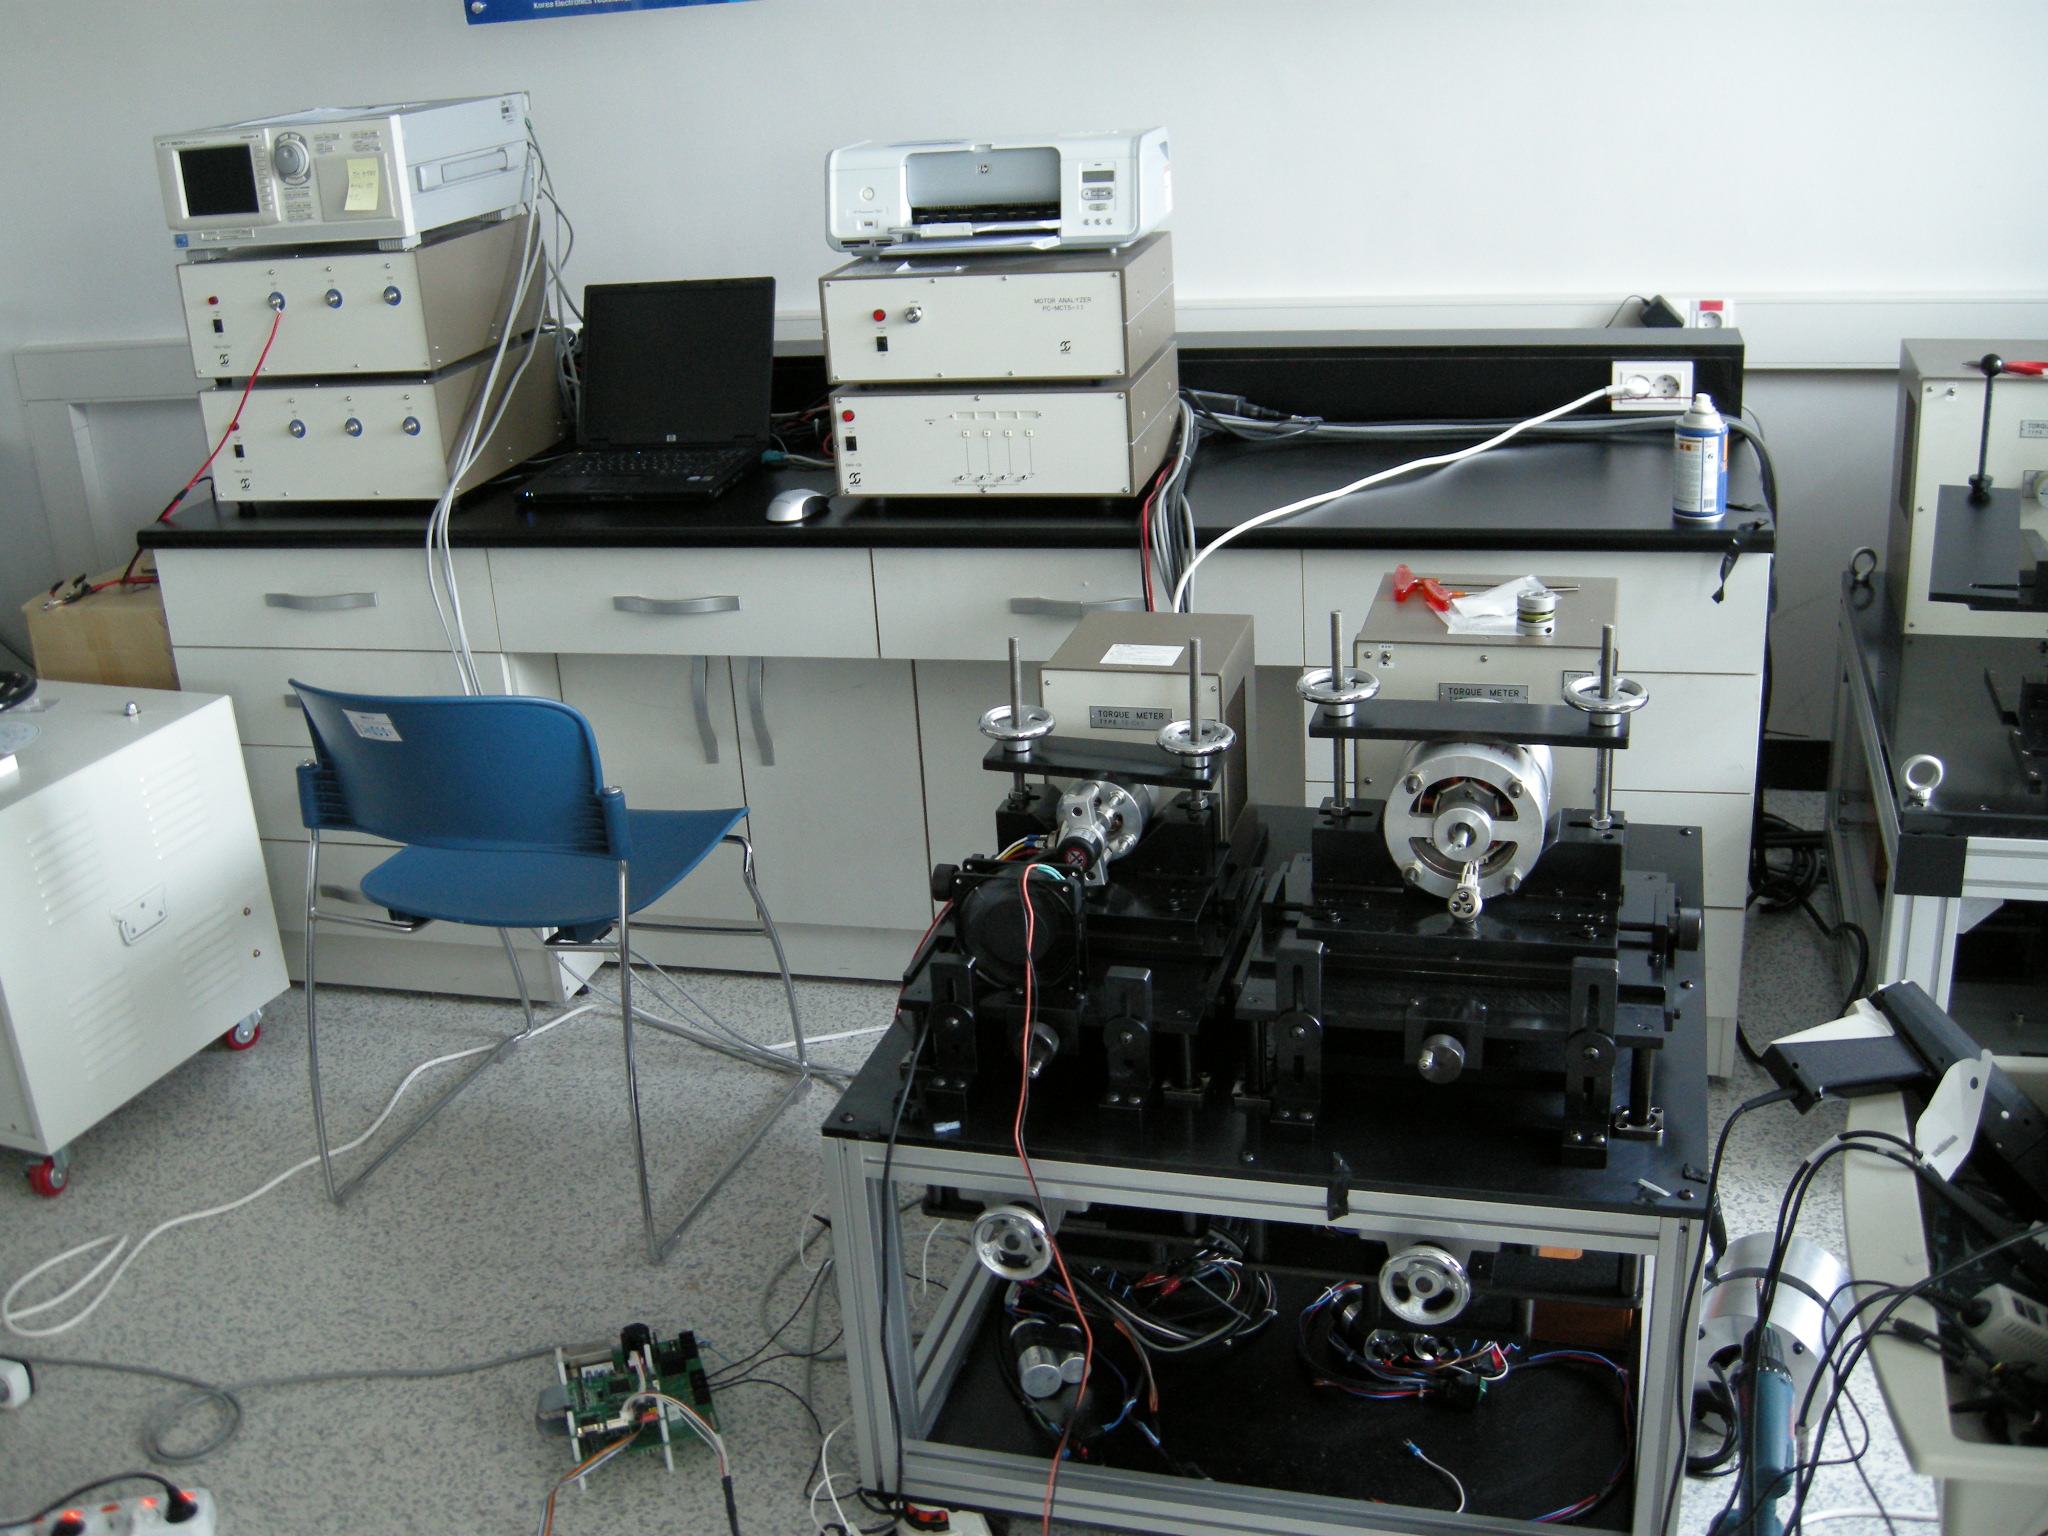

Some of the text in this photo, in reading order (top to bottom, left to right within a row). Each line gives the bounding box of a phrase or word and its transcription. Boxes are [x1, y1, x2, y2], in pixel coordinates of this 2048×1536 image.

[533, 1, 554, 9] Korea
[1058, 296, 1092, 304] ANALYZER
[1448, 687, 1520, 698] TORQUE METER
[1098, 710, 1164, 720] TORQUE METER
